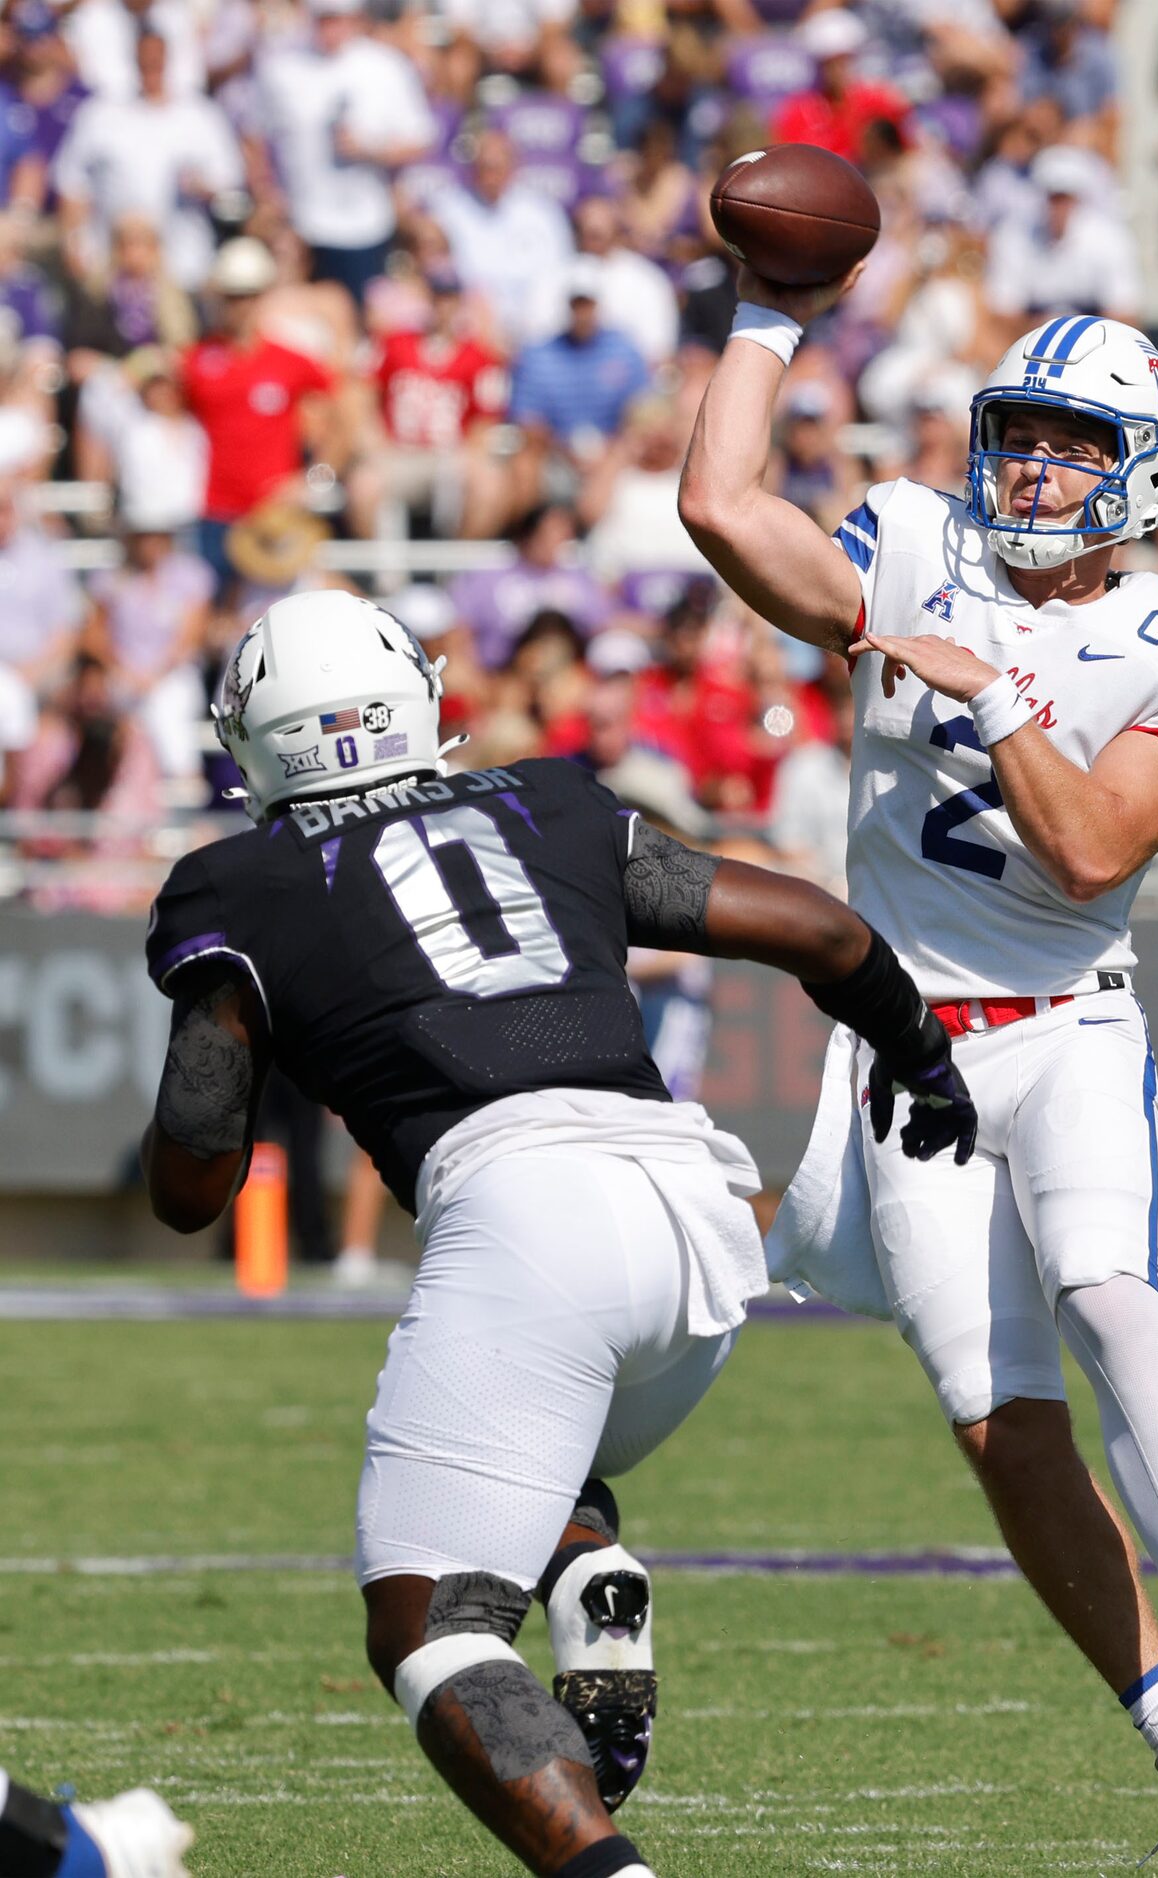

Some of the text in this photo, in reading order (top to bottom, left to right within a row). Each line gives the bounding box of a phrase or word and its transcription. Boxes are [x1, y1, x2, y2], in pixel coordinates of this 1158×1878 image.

[1022, 376, 1047, 389] 214
[364, 706, 390, 730] 38
[335, 735, 359, 768] 0
[922, 715, 1007, 881] 2
[369, 804, 573, 1000] 0
[1108, 975, 1117, 987] L
